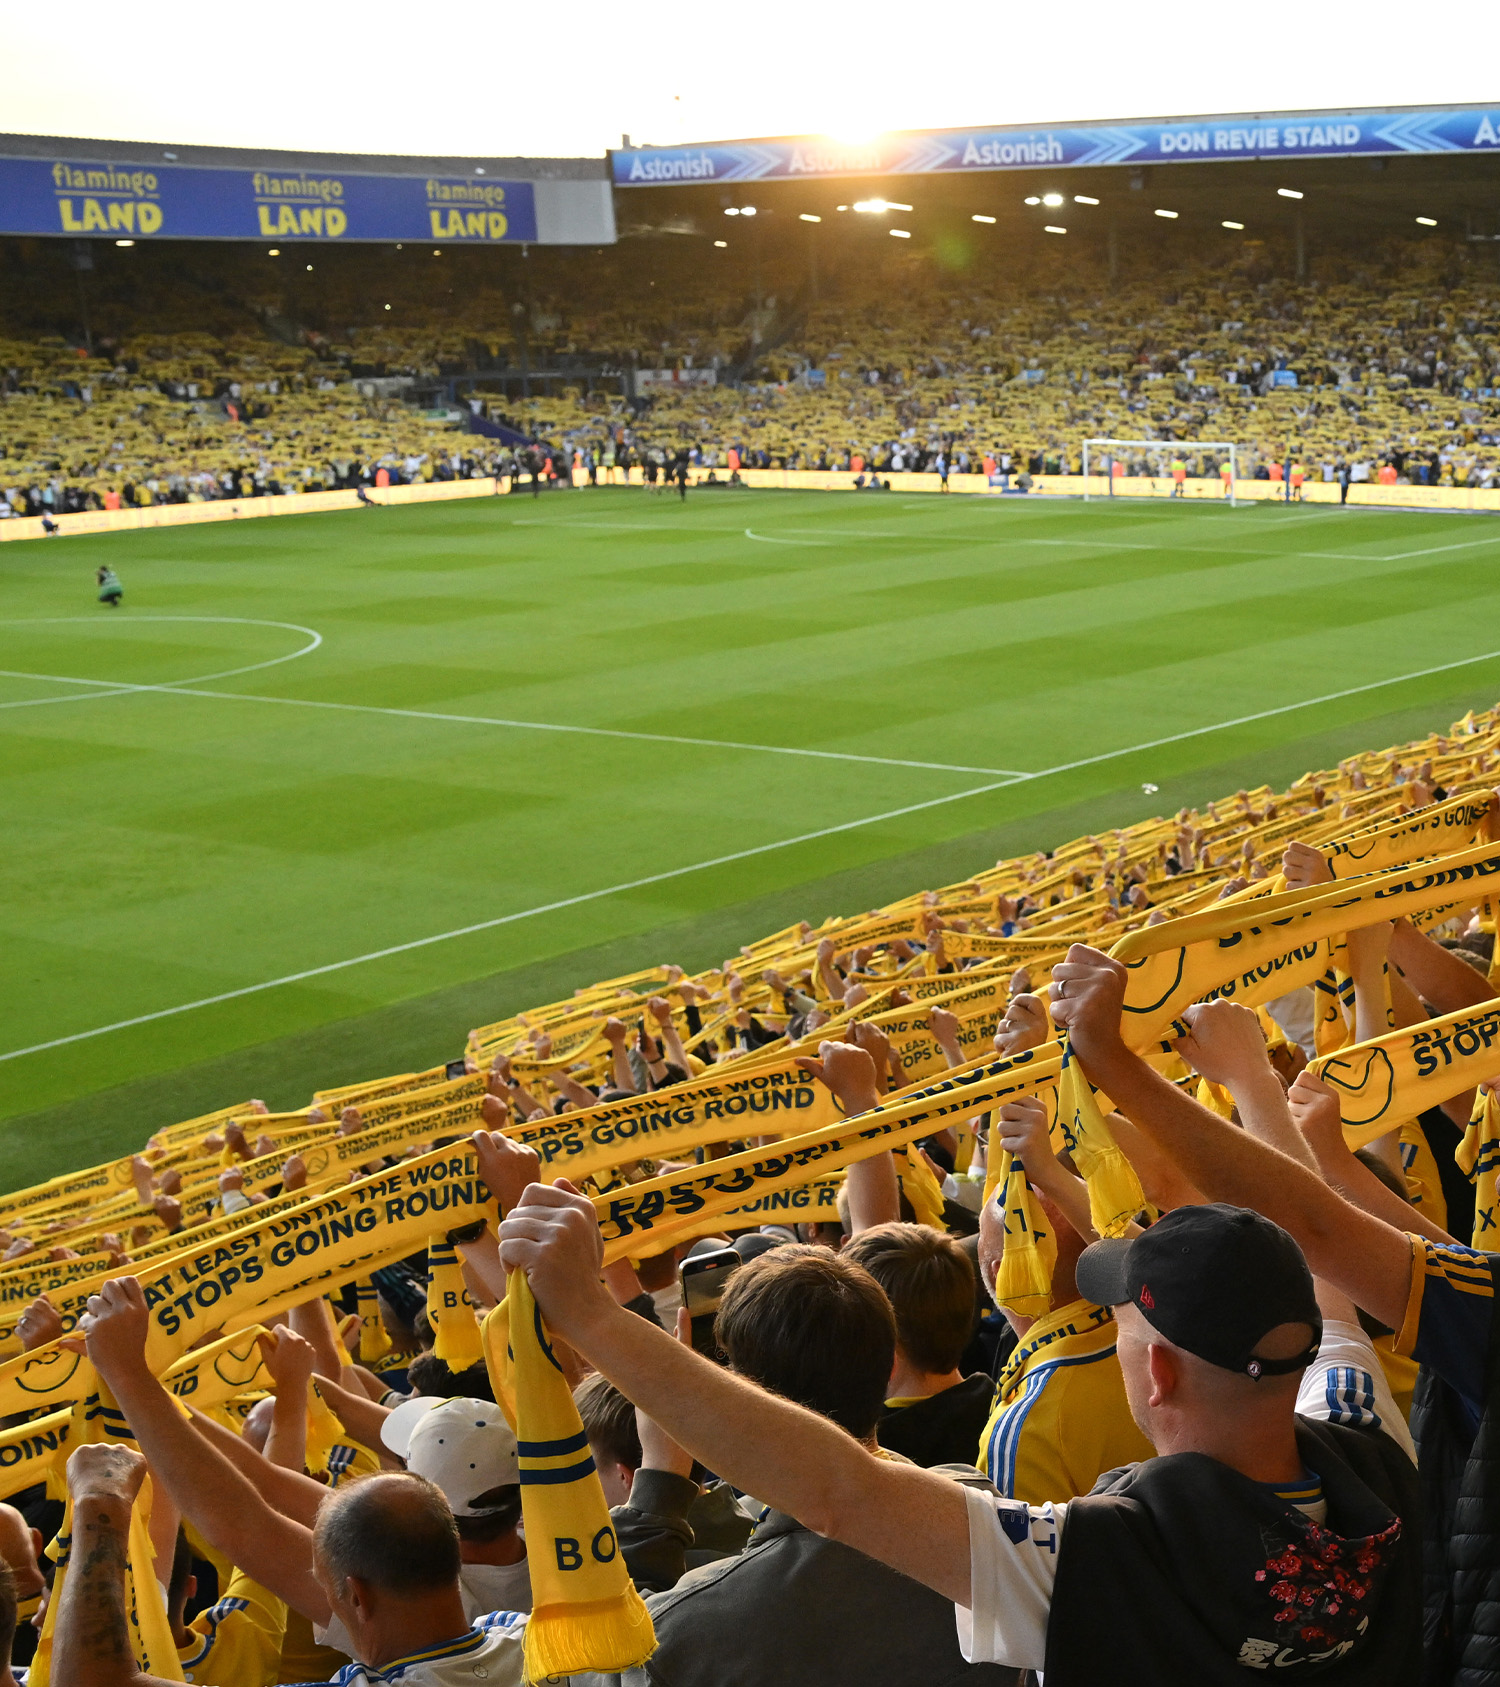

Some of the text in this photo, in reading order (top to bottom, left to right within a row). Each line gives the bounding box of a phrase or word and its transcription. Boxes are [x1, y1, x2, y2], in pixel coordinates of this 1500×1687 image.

[962, 135, 1062, 167] Astonish
[1159, 125, 1360, 154] DON REVIE STAND
[52, 163, 157, 197] flamingo
[629, 152, 714, 182] Astonish
[253, 173, 343, 201] flamingo
[427, 178, 504, 206] flamingo
[59, 199, 163, 233] LAND
[258, 205, 347, 237] LAND
[430, 209, 507, 238] LAND
[591, 1098, 669, 1123] UNTIL
[672, 1082, 723, 1103] THE
[725, 1069, 815, 1094] WORLD
[591, 1106, 695, 1145] GOING
[705, 1087, 815, 1120] ROUND
[19, 1187, 60, 1207] GOING
[64, 1176, 109, 1193] ROUND
[134, 1239, 171, 1262] EAST
[177, 1223, 222, 1248] UNTIL
[227, 1211, 250, 1232] THE
[144, 1158, 481, 1310] AT LEAST UNTIL THE WORL
[31, 1265, 61, 1279] THE
[68, 1260, 108, 1274] WOR
[157, 1255, 264, 1336] STOPS
[271, 1207, 376, 1267] GOING
[386, 1180, 491, 1224] ROUND
[1, 1283, 41, 1301] ING
[555, 1526, 616, 1571] BO
